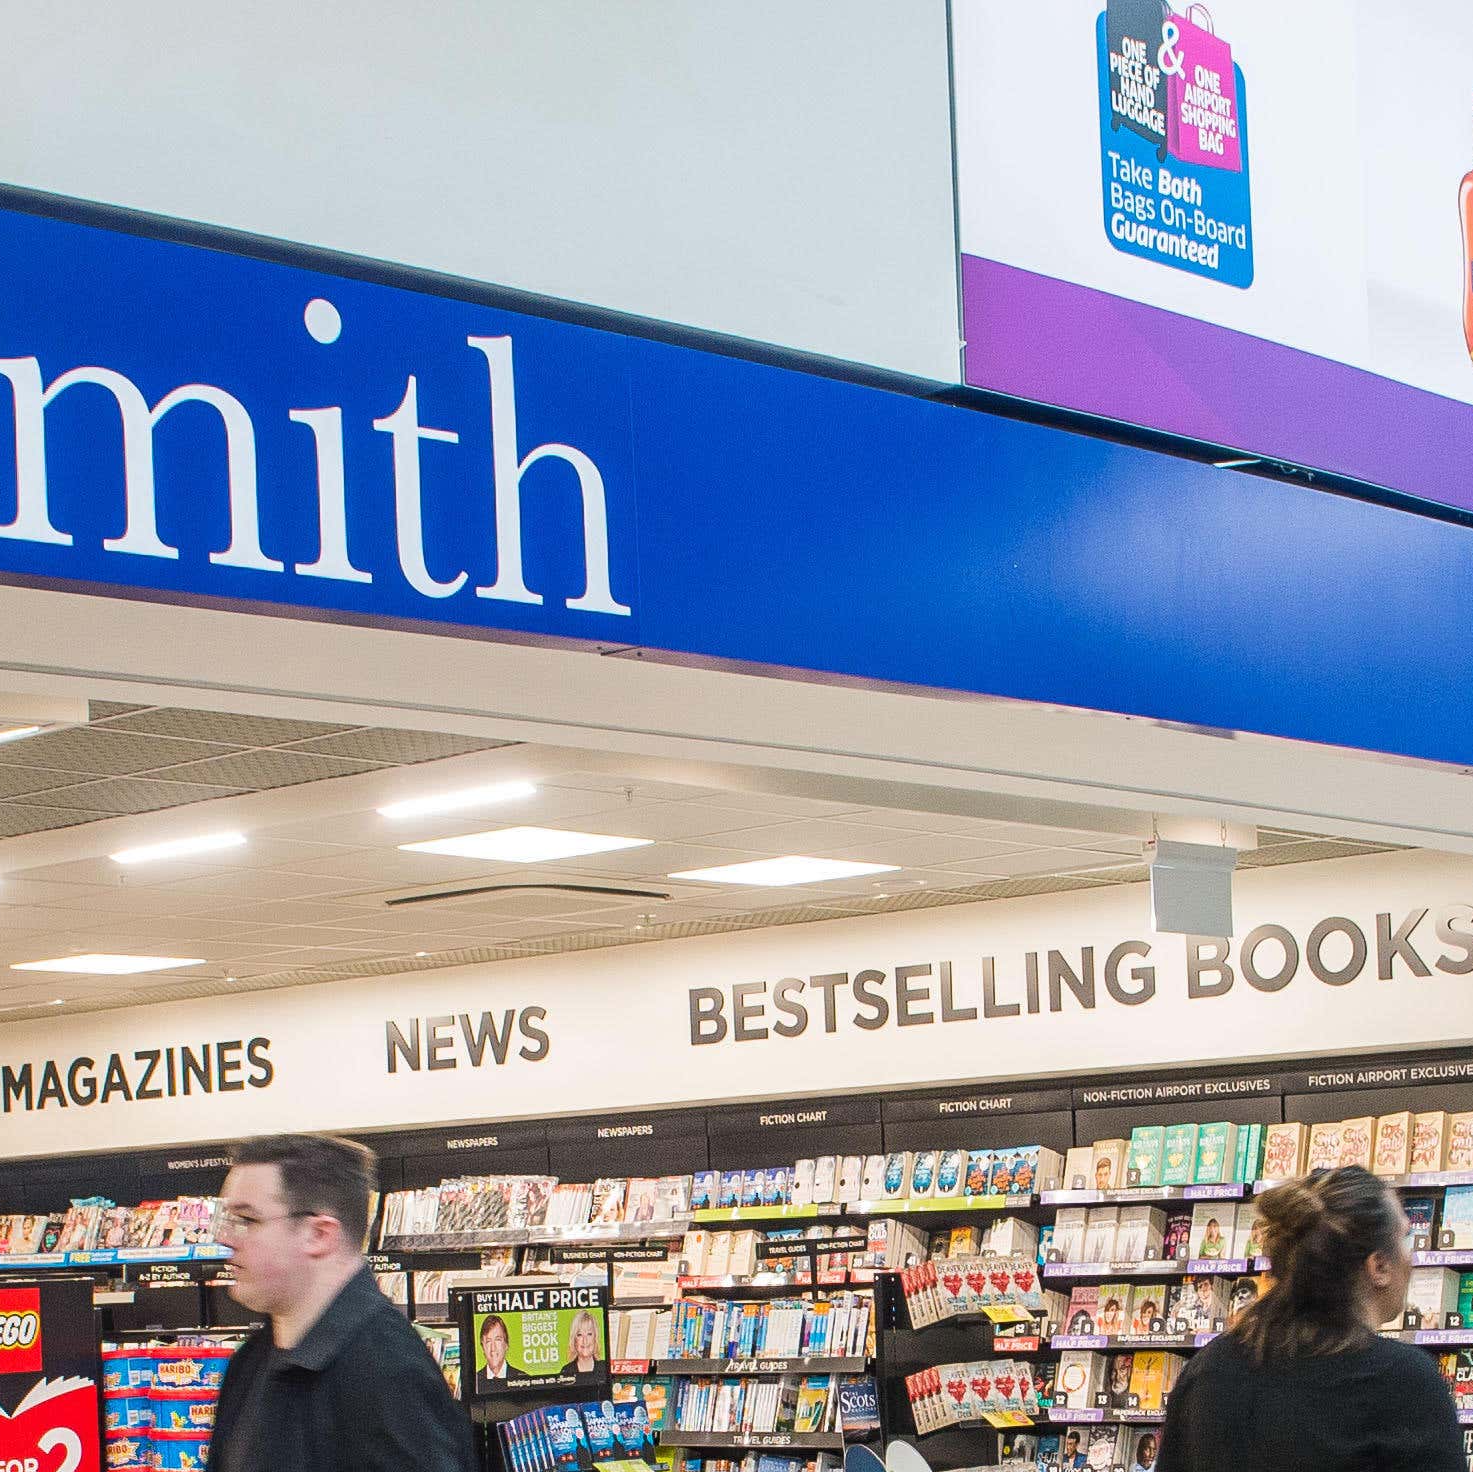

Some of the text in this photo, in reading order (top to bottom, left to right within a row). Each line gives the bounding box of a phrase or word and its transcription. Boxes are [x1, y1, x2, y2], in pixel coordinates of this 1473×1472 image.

[1121, 36, 1147, 65] ONE
[1158, 21, 1185, 80] &
[1110, 52, 1160, 90] PIECE OF
[1194, 64, 1220, 93] ONE
[1121, 76, 1155, 107] HAND
[1184, 83, 1231, 117] AIRPORT
[1112, 91, 1165, 136] LUGGAGE
[1181, 105, 1236, 138] SHOPPING
[1198, 130, 1223, 155] BAG
[1108, 151, 1202, 206] Take Both
[1110, 182, 1246, 250] Bags On-Board
[1111, 212, 1218, 269] Guaranteed
[687, 937, 1155, 1047] BESTSELLING
[385, 1003, 551, 1075] NEWS
[0, 1035, 275, 1115] MAGAZINES
[1308, 1073, 1354, 1087] FICTION
[1357, 1070, 1407, 1083] AIRPORT
[1083, 1079, 1270, 1103] NON-FICTION AIRPORT EXCLUSIVES
[939, 1098, 1012, 1113] FICTION CHART
[760, 1110, 827, 1126] FICTION CHART
[447, 1137, 498, 1149] NEWSPAPERS
[598, 1125, 653, 1139] NEWSPAPERS
[167, 1156, 234, 1170] WOMEN'S LIFESTYL
[769, 1245, 806, 1254] TRAVEL GUIDES
[1194, 1263, 1241, 1273] HALF PRICE
[476, 1294, 492, 1303] BUY
[477, 1304, 492, 1312] GET
[498, 1289, 599, 1311] HALF PRICE
[522, 1322, 557, 1333] BIGGEST
[522, 1333, 558, 1347] BOOK
[523, 1348, 559, 1363] CLUB
[760, 1360, 788, 1370] GUIDES
[160, 1363, 191, 1375] HARIBO
[840, 1390, 876, 1415] Scots
